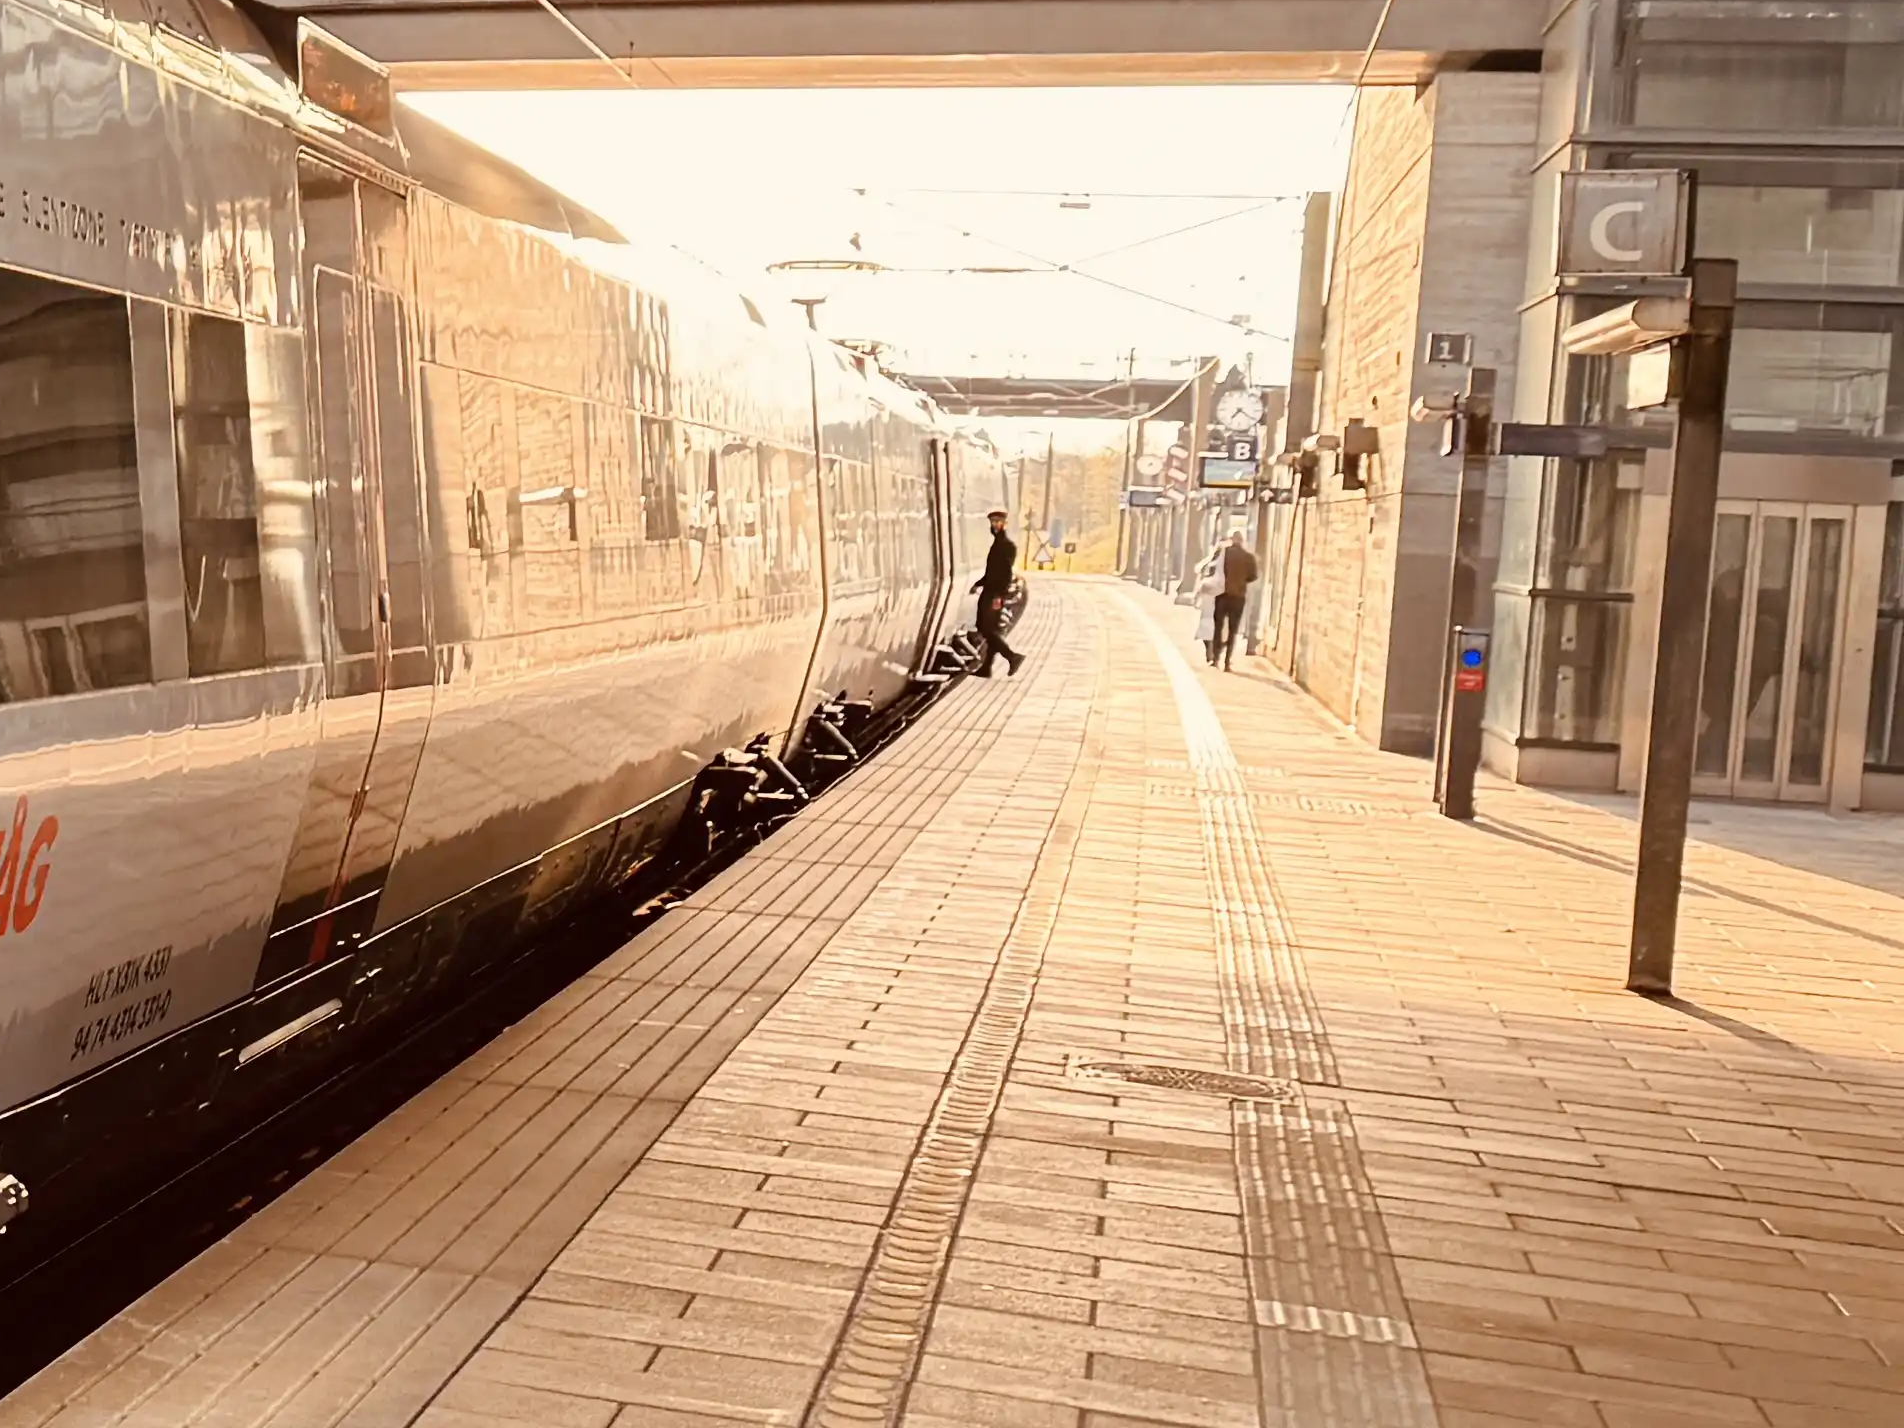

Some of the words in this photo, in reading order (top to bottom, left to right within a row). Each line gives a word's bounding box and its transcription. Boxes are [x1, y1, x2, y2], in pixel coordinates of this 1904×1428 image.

[1589, 201, 1644, 262] C
[1439, 341, 1454, 360] 1
[1234, 442, 1252, 460] B
[70, 1022, 93, 1062] 94
[90, 1014, 112, 1053] 74
